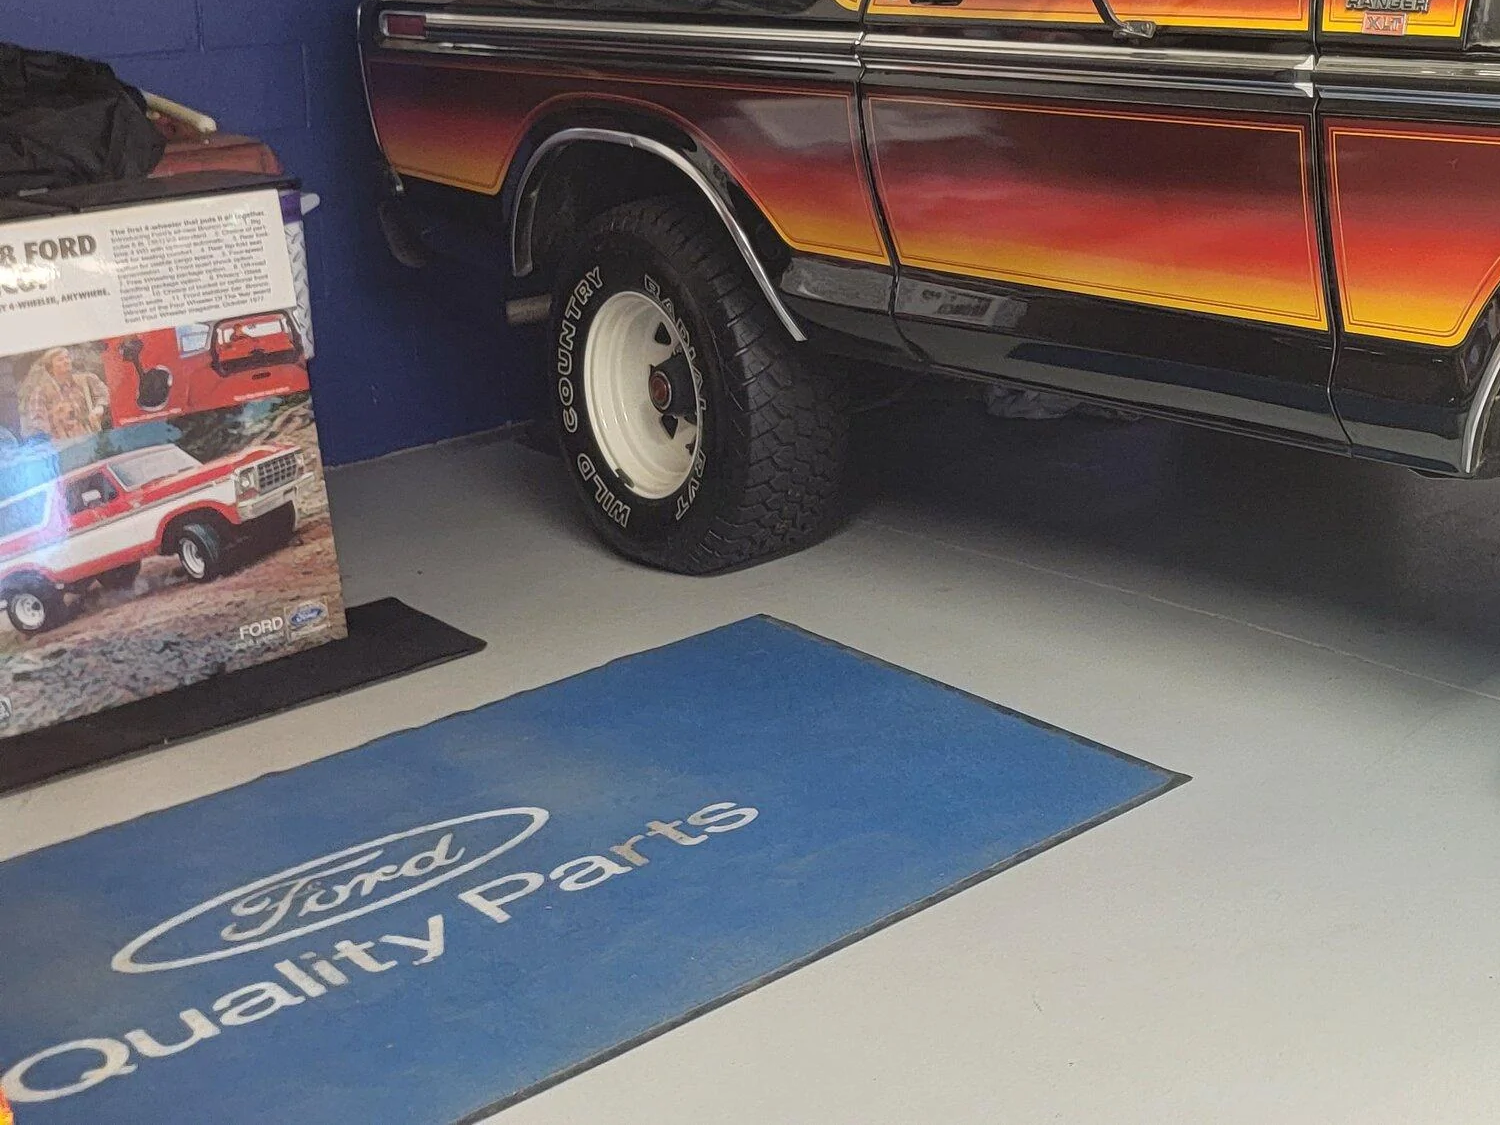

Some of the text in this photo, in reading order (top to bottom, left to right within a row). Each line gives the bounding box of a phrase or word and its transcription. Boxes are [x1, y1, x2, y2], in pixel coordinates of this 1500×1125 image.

[1366, 15, 1402, 32] XLT
[24, 234, 97, 265] FORD
[557, 266, 632, 528] WILD COUNTRY
[240, 616, 284, 640] FORD
[222, 832, 465, 942] Ford
[2, 801, 760, 1103] Quality Parts
